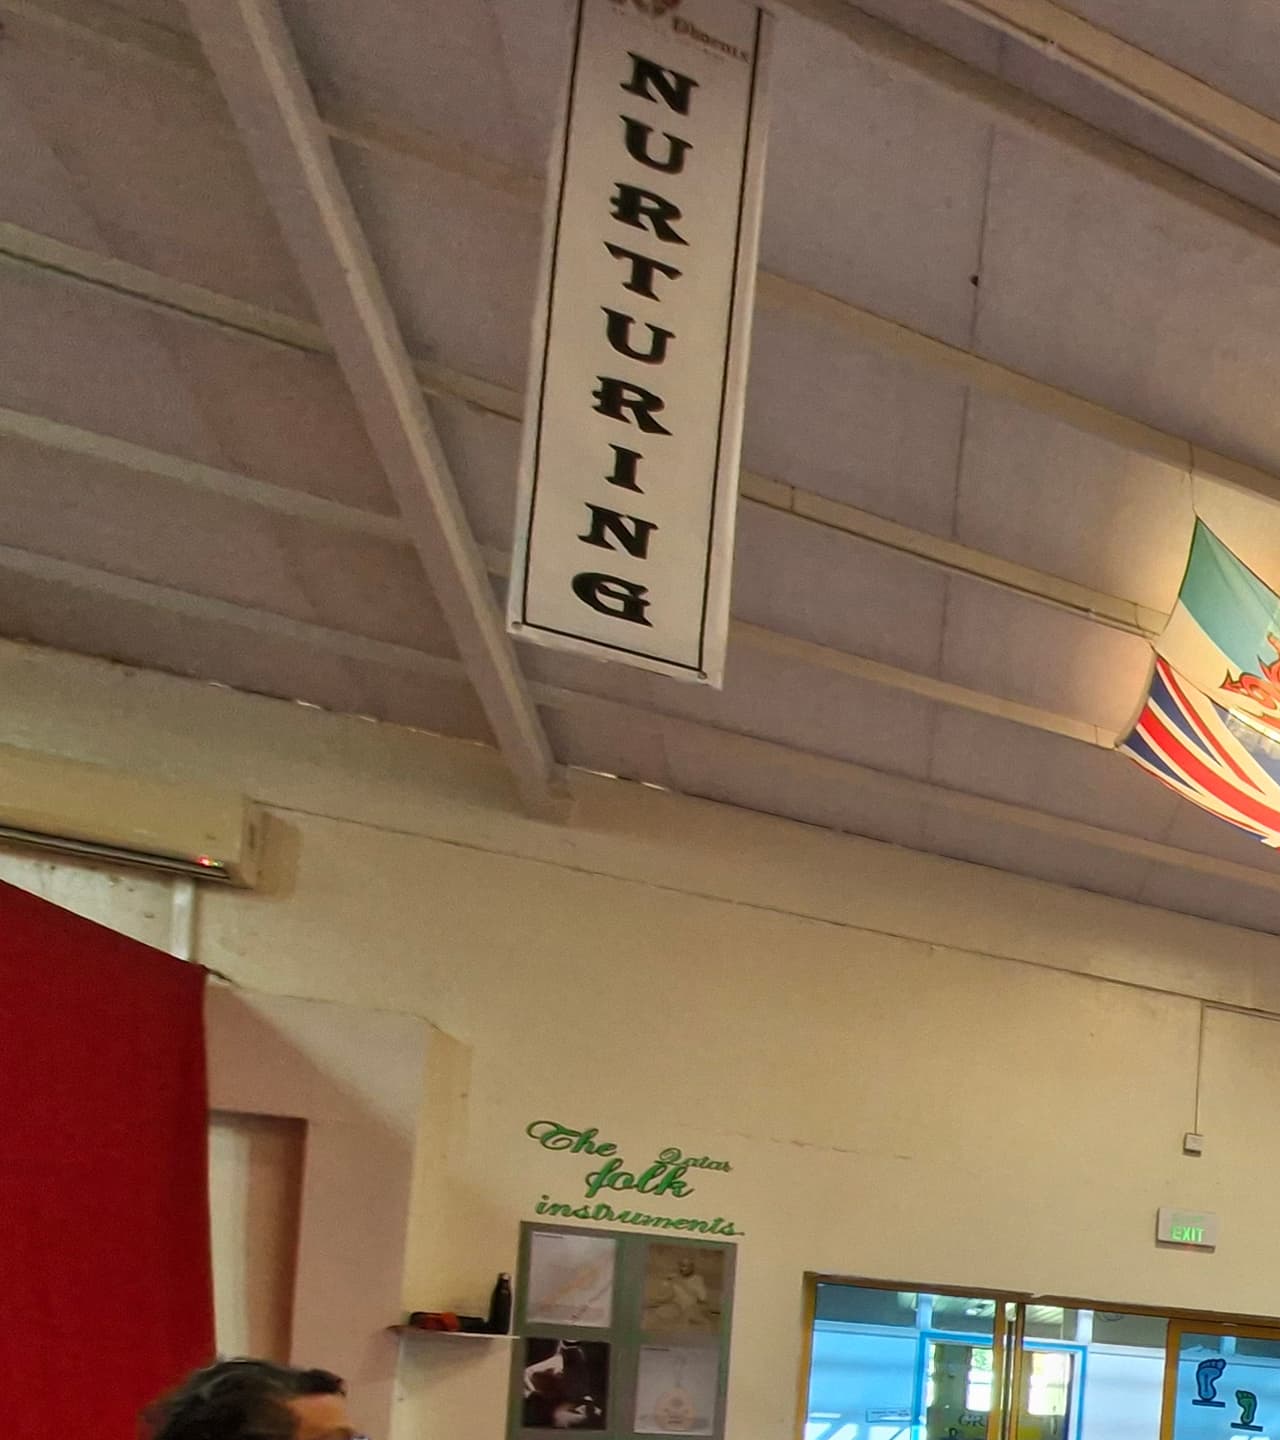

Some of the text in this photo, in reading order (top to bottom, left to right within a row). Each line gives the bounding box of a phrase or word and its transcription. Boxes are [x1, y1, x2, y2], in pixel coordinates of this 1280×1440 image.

[571, 51, 699, 628] NURTURING
[526, 1120, 617, 1157] The
[585, 1158, 695, 1198] folk
[535, 1195, 745, 1237] instruments
[1171, 1225, 1205, 1242] EXIT
